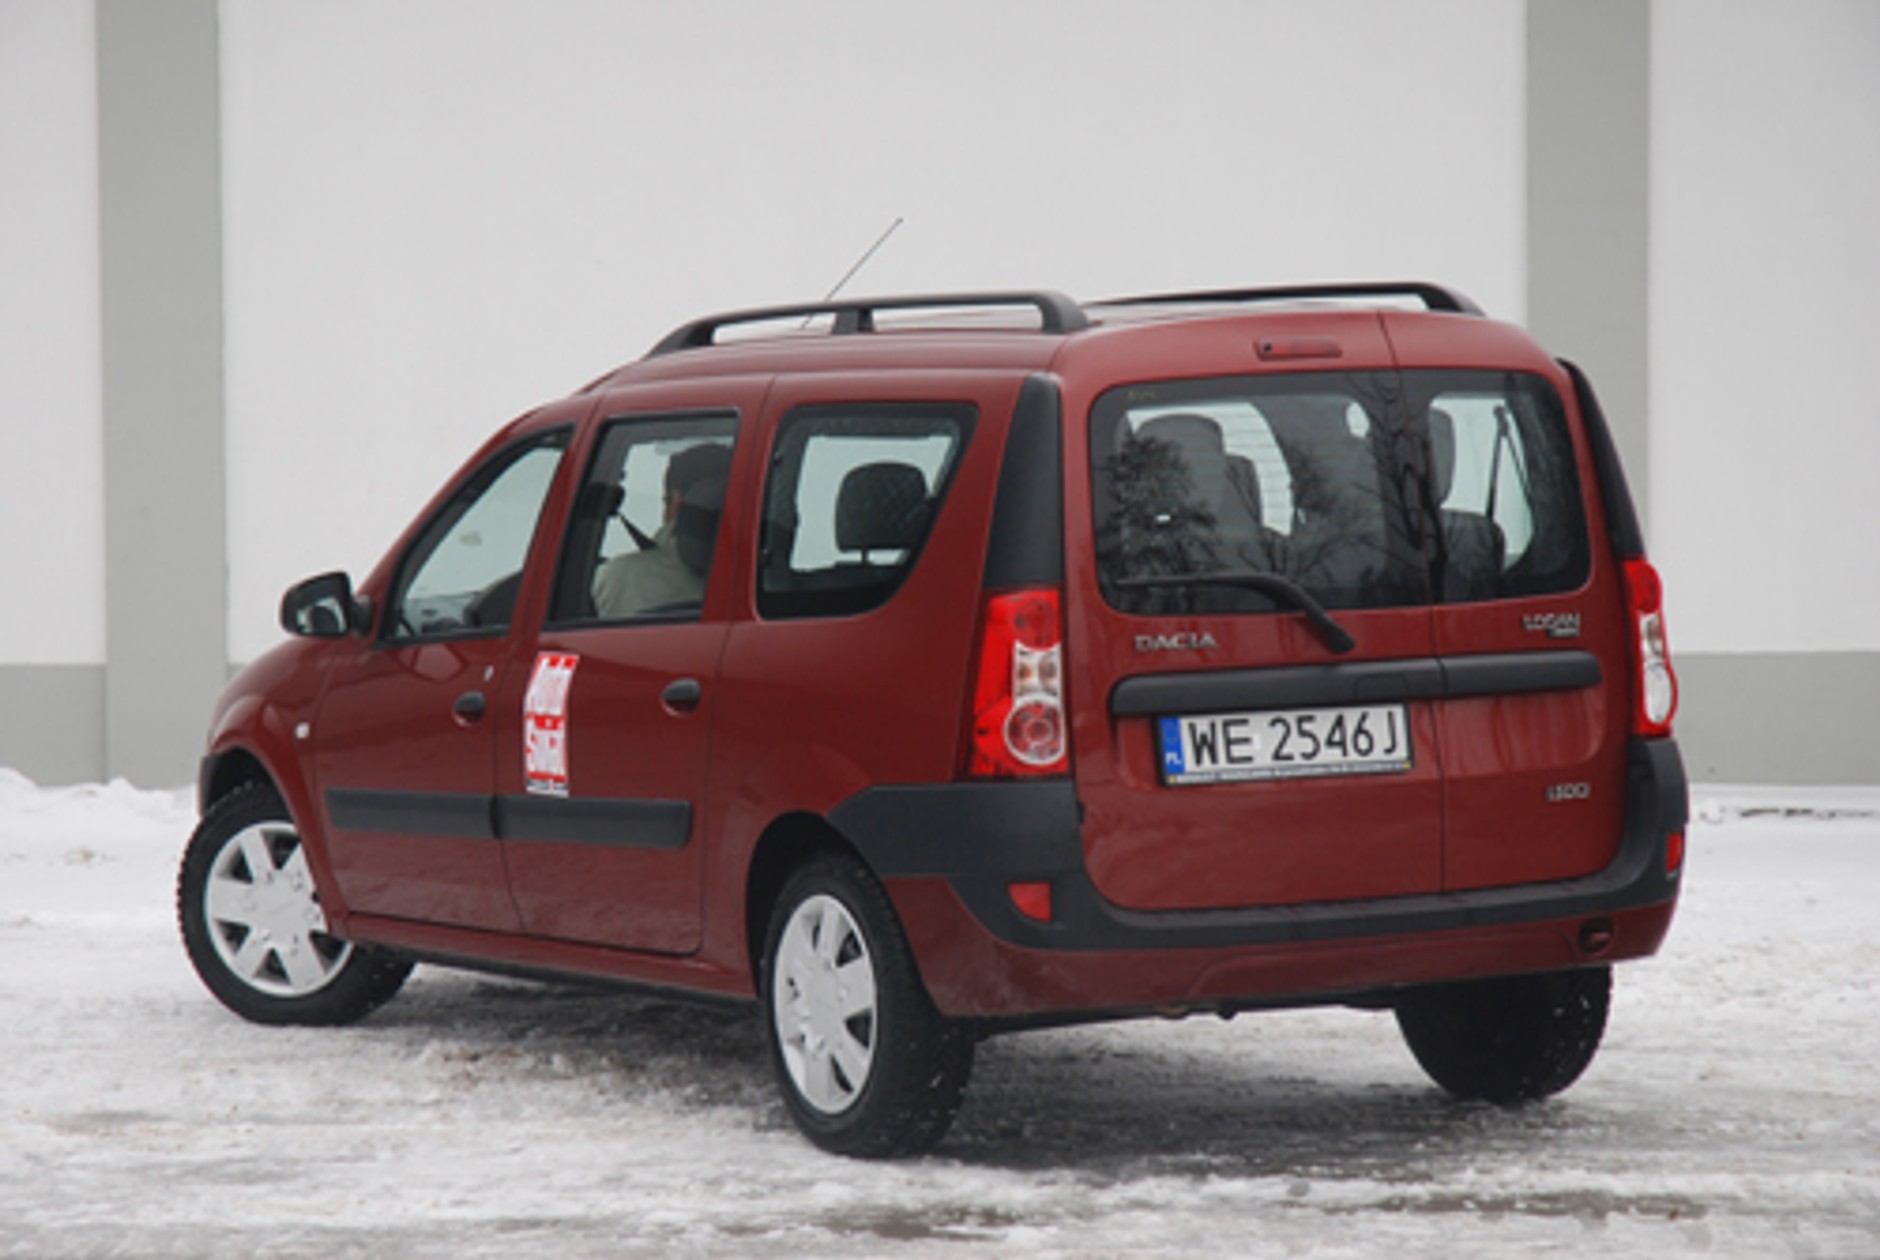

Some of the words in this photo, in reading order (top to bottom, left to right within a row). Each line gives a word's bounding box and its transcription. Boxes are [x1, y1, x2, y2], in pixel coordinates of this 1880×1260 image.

[1134, 631, 1218, 652] DACIA
[1187, 717, 1254, 767] WE
[1268, 710, 1397, 763] 2546J
